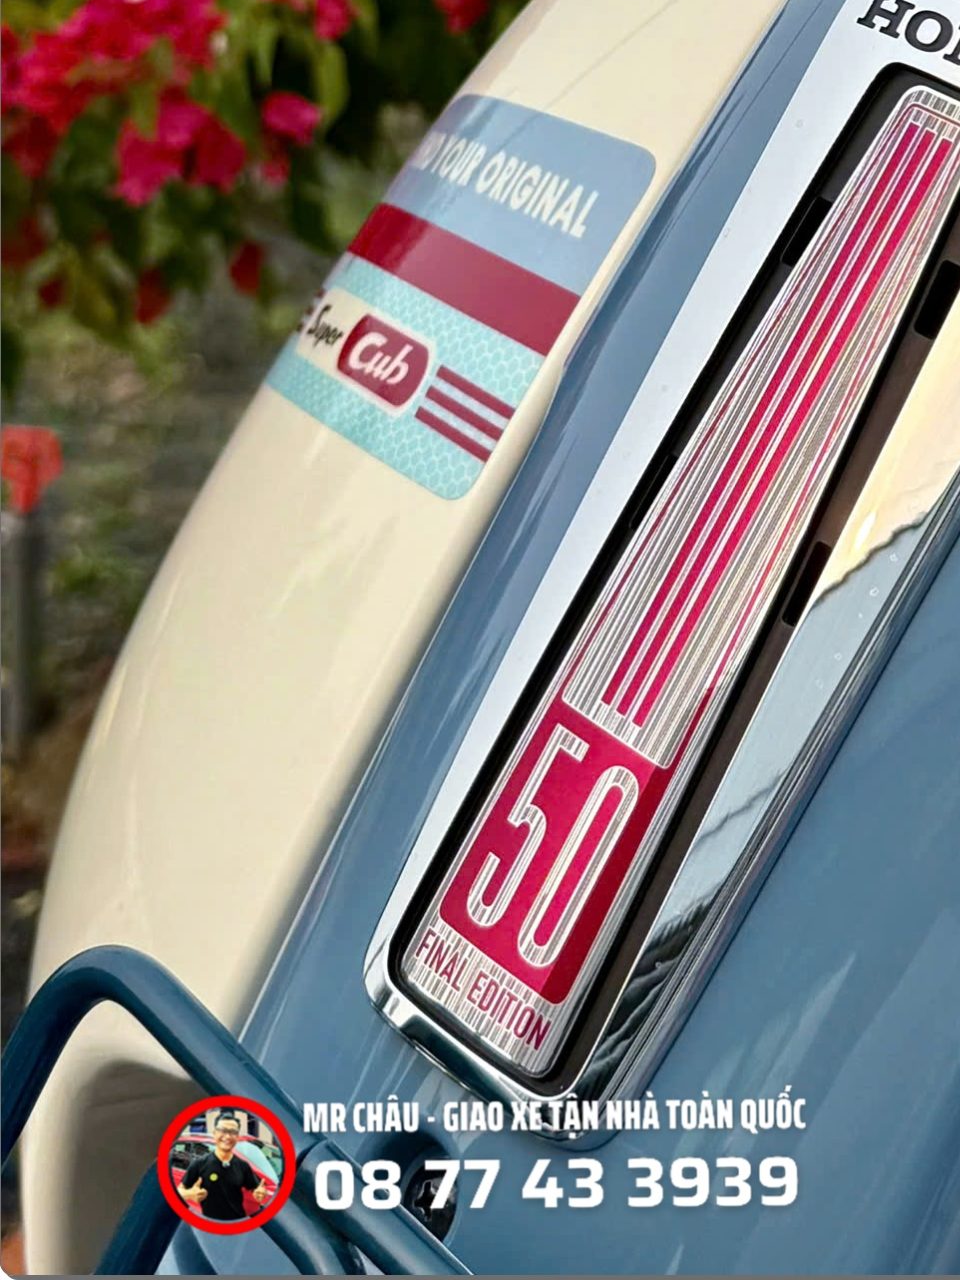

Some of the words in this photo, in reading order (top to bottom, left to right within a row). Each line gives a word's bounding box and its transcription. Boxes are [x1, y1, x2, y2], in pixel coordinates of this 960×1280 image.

[429, 133, 488, 187] YOUR
[475, 149, 599, 239] ORIGINAL
[307, 304, 344, 348] Super
[348, 331, 414, 385] Cub
[466, 722, 640, 969] 50
[415, 927, 469, 992] FINAL
[466, 970, 552, 1052] EDITION
